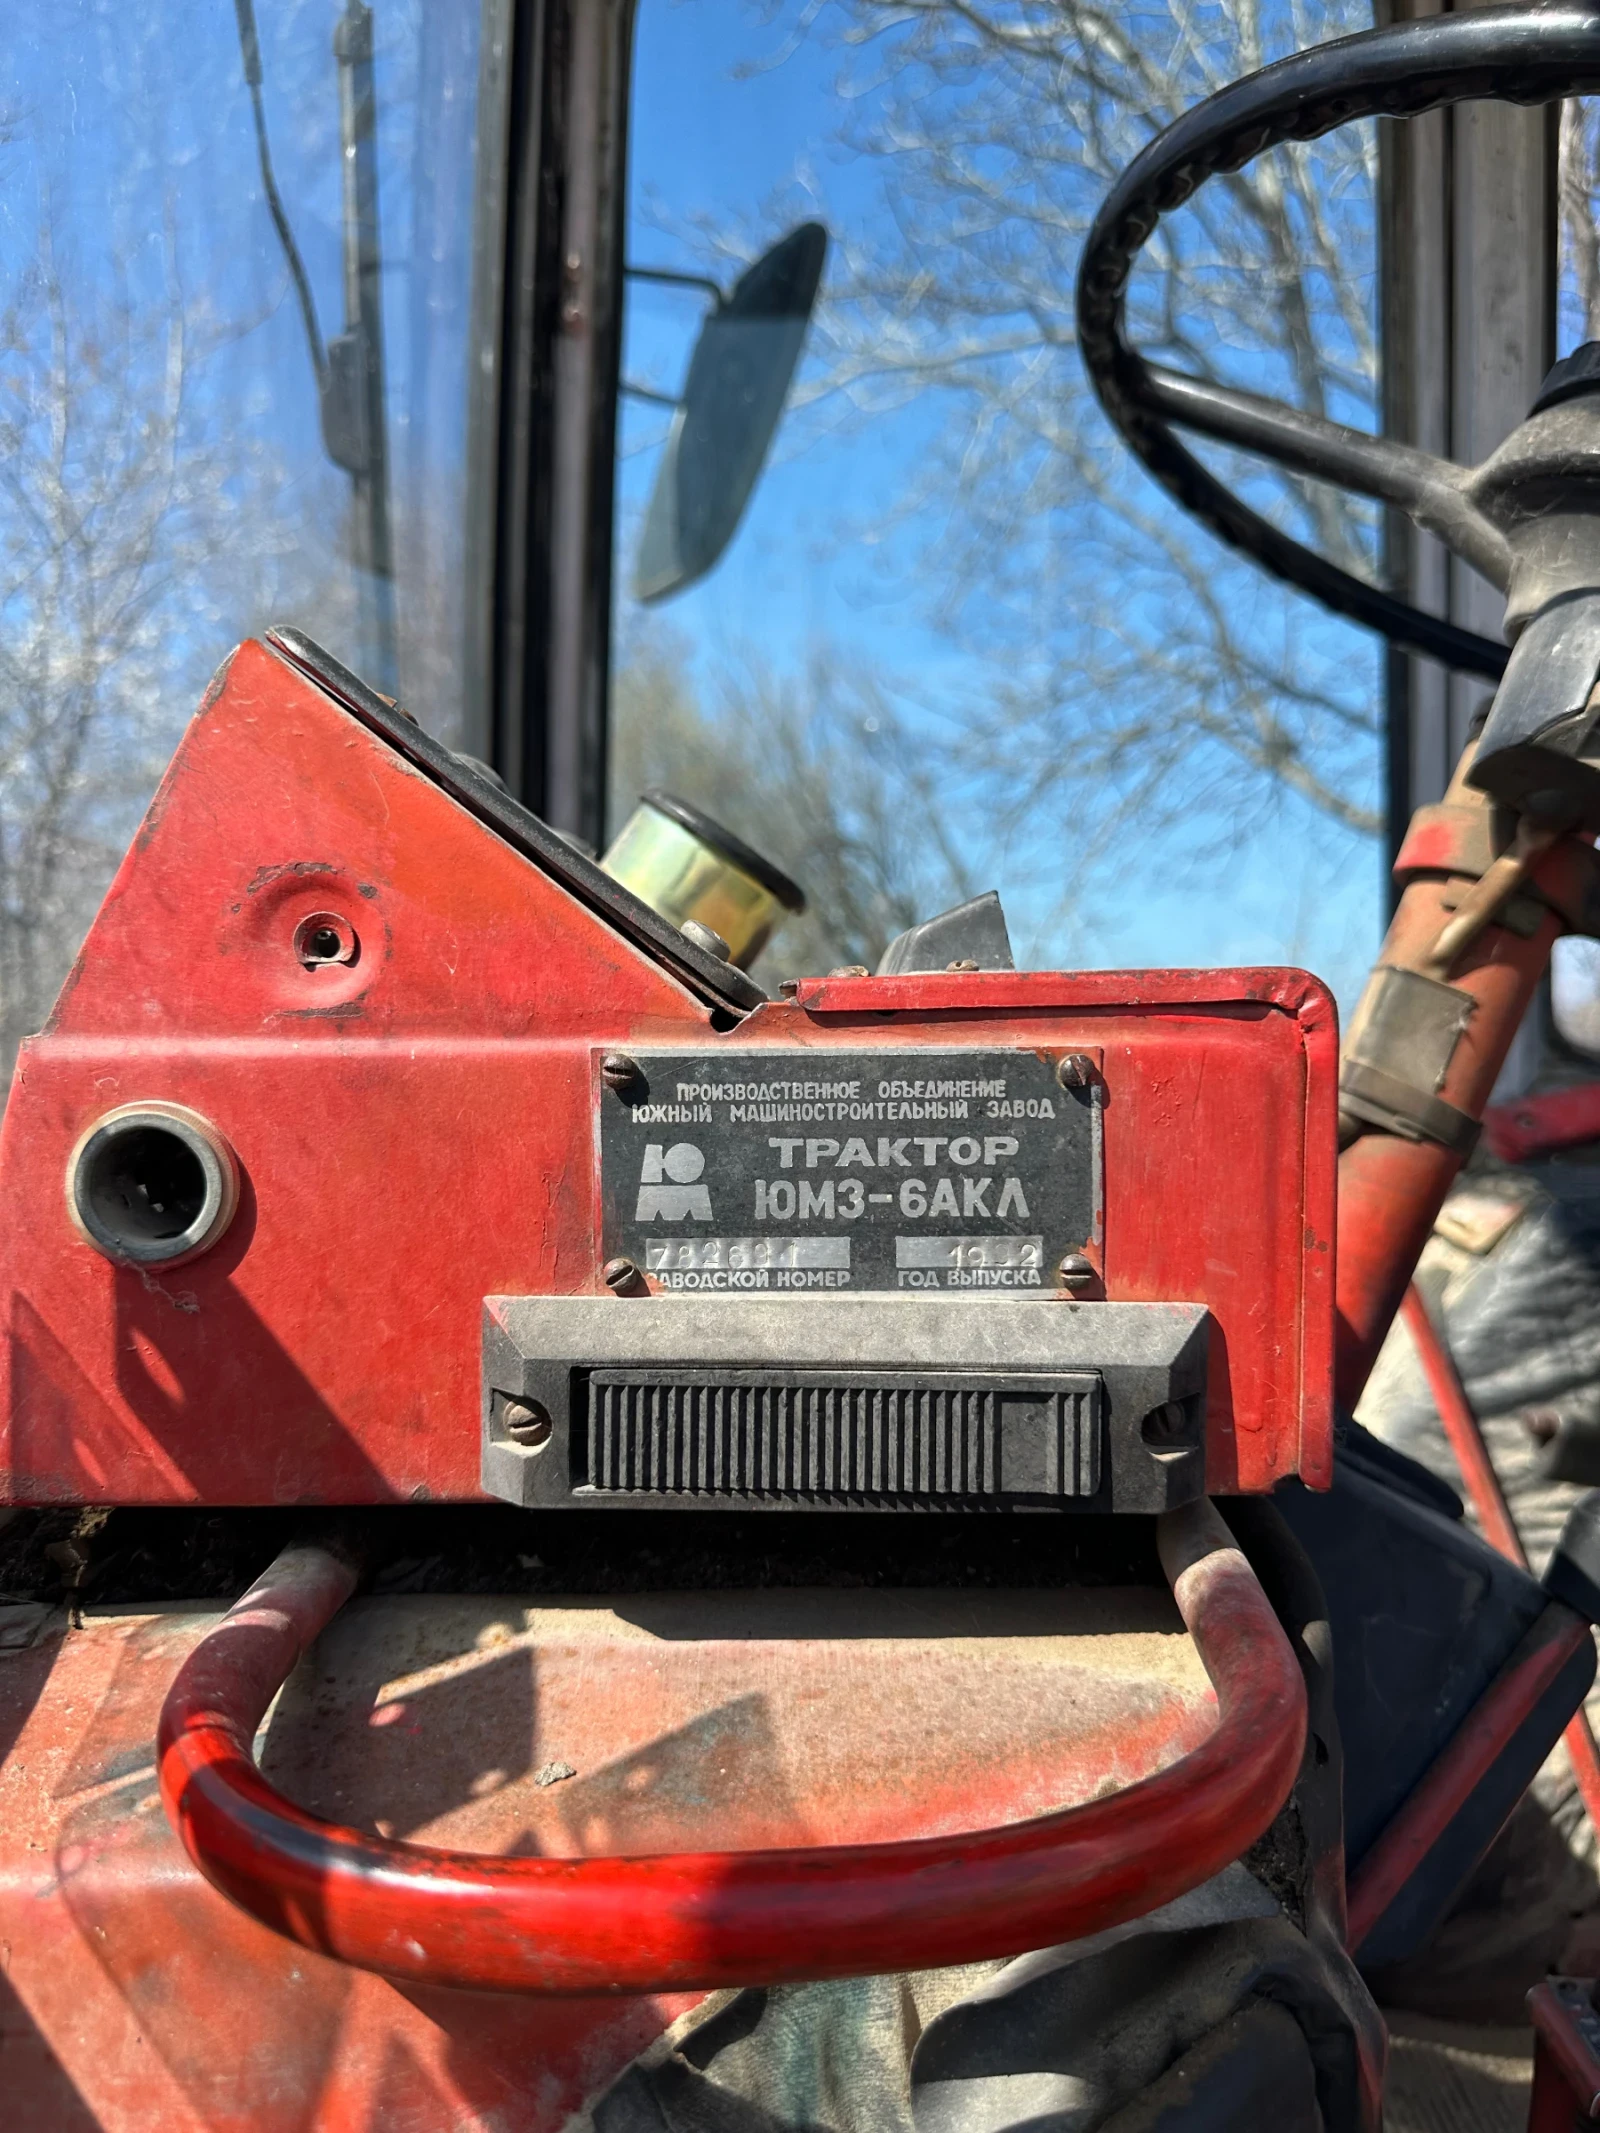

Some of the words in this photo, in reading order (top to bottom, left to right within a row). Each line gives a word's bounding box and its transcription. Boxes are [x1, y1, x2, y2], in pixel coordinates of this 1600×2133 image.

[677, 1080, 861, 1102] ПРОИЗВОДСТВЕННОЕ
[878, 1079, 1007, 1099] ОБЪЕДИНЕНИЕ
[632, 1102, 713, 1124] ЮЖНЫЙ
[730, 1100, 969, 1123] МАШИНОСТРОИТЕЛЬНЫЙ
[986, 1099, 1056, 1119] ЗАВОД
[768, 1136, 1020, 1168] ТРАКТОР
[754, 1177, 1031, 1220] ЮМЗ-6АКЛ
[777, 1271, 851, 1287] НОМЕР
[897, 1271, 940, 1288] ГОД
[946, 1269, 1042, 1286] ВЫПУСКА
